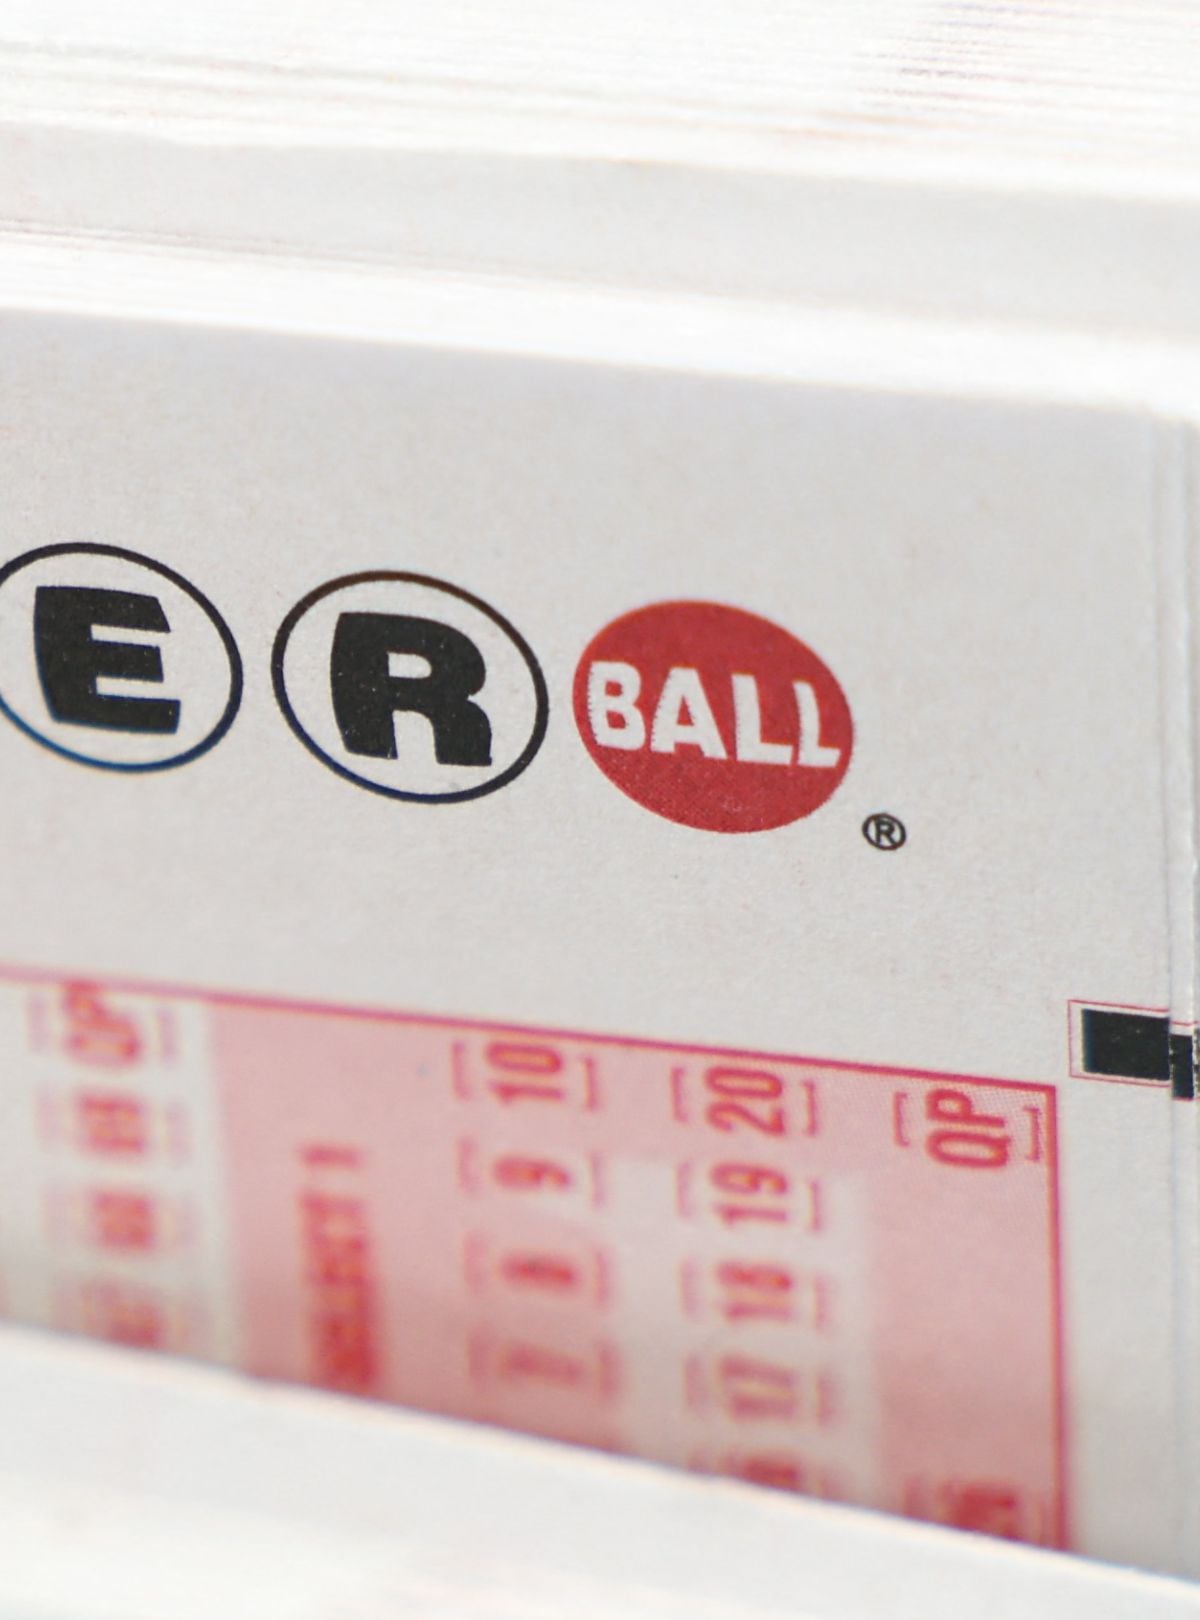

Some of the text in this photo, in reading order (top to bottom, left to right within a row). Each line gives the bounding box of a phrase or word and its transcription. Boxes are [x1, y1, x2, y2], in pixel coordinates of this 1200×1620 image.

[484, 1041, 564, 1104] 10
[704, 1066, 787, 1137] 20
[924, 1087, 1010, 1169] QP
[492, 1154, 571, 1194] 9
[709, 1161, 788, 1227] 19
